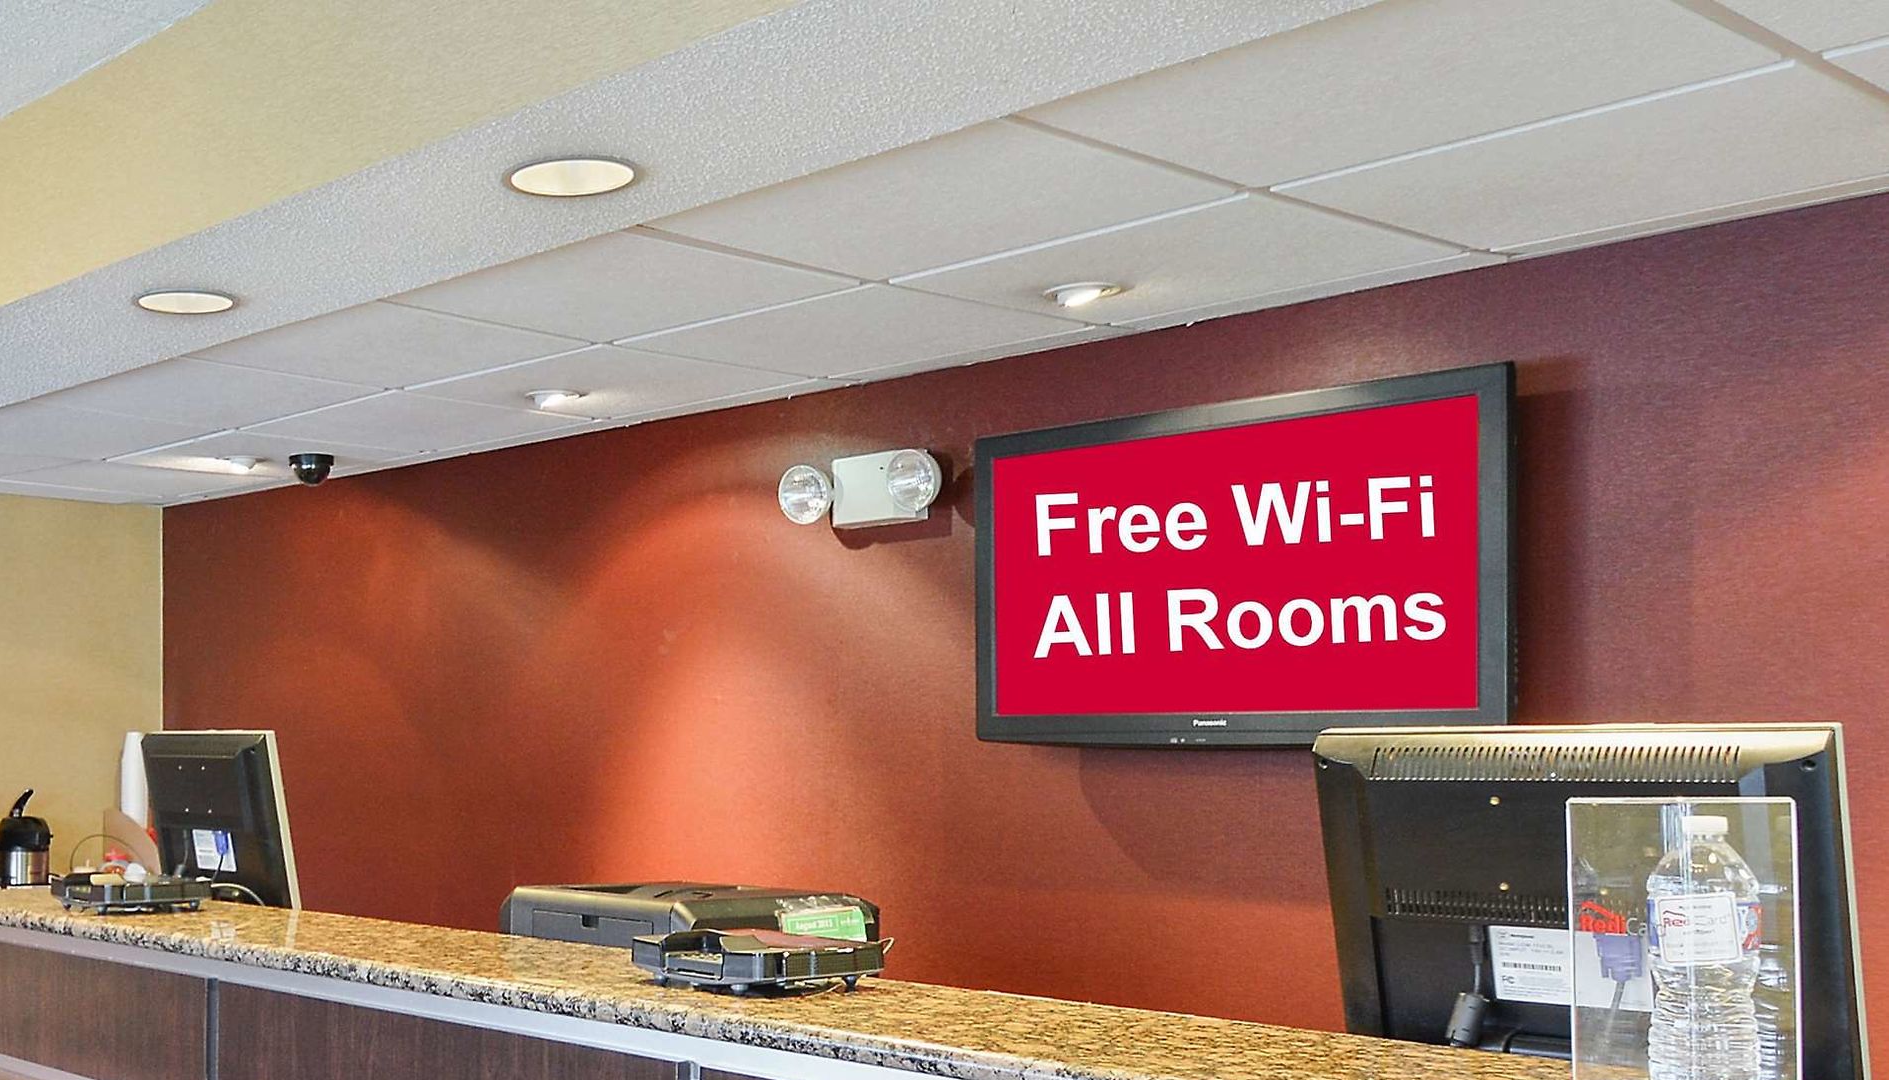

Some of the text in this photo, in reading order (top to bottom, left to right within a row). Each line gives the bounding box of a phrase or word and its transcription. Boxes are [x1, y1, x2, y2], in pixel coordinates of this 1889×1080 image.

[1035, 475, 1435, 556] Free Wi-Fi
[1033, 588, 1447, 659] All Rooms
